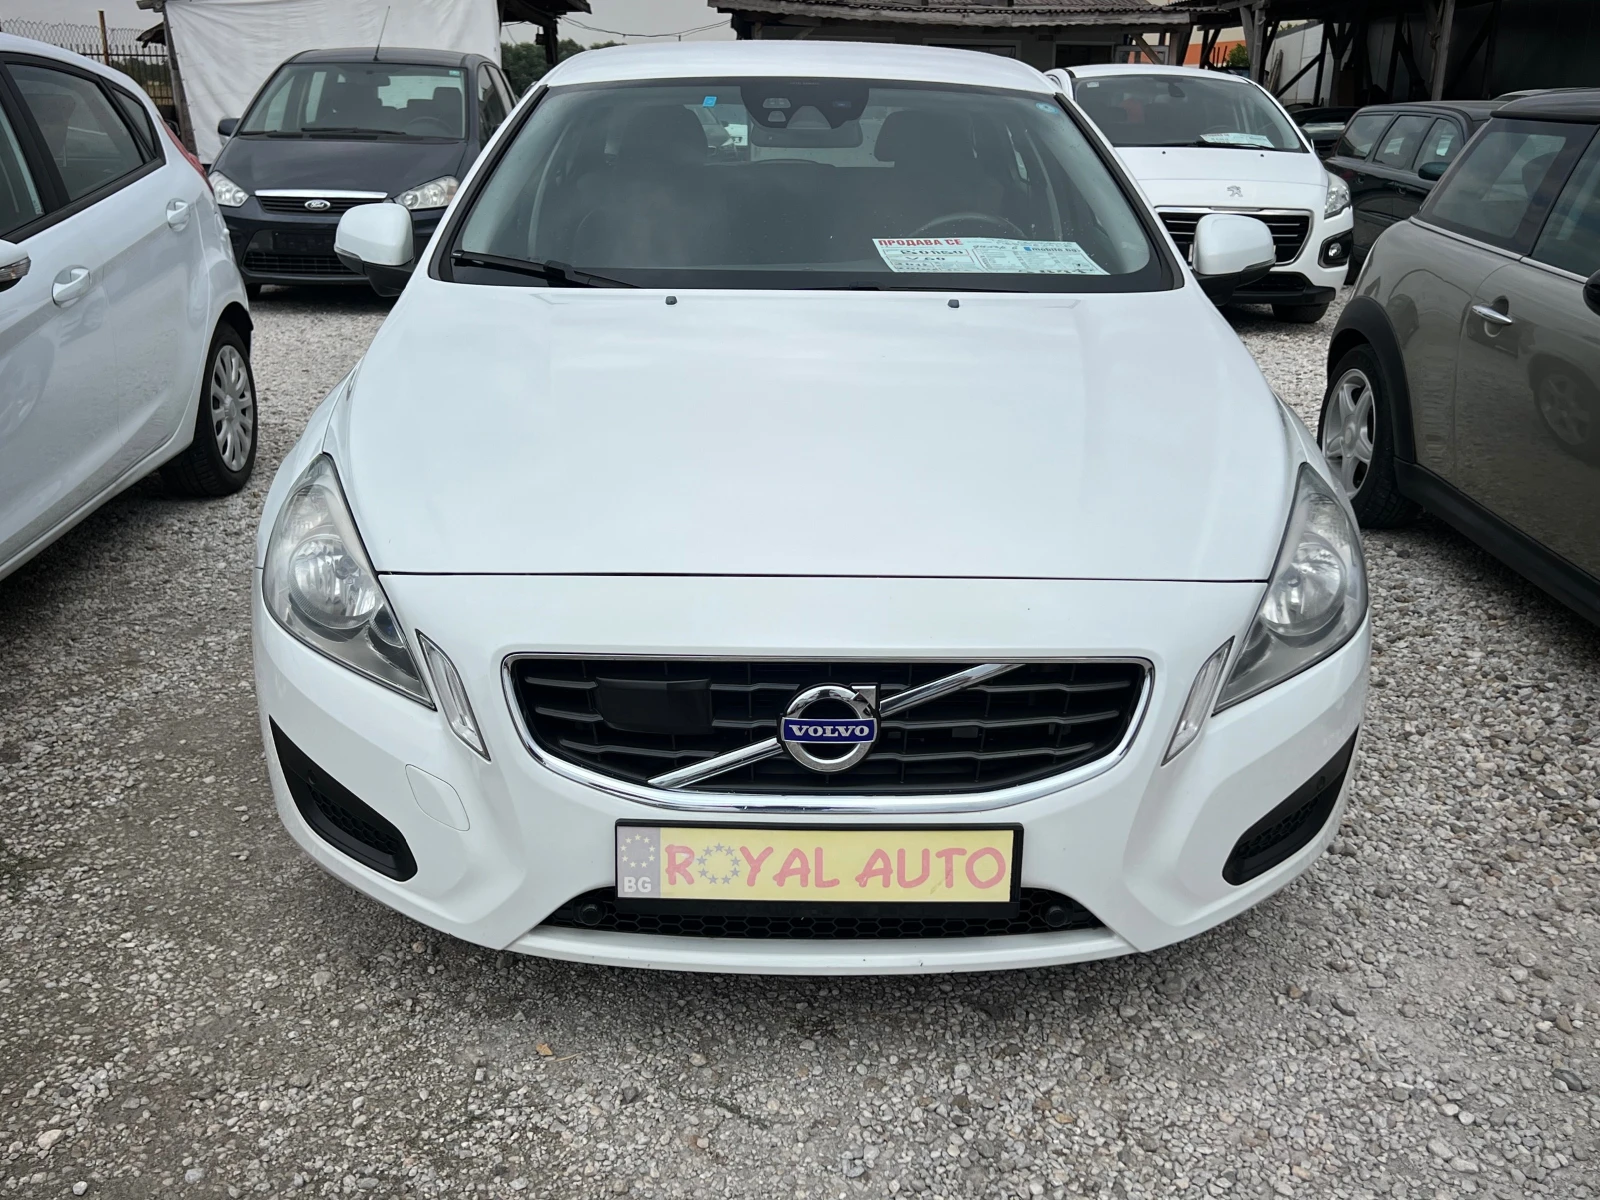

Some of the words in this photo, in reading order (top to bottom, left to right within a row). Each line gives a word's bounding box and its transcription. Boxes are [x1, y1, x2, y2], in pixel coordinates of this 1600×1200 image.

[788, 724, 870, 737] VOLVO
[664, 842, 840, 889] ROYAL
[855, 846, 1007, 889] AUTO
[623, 875, 652, 893] BG
